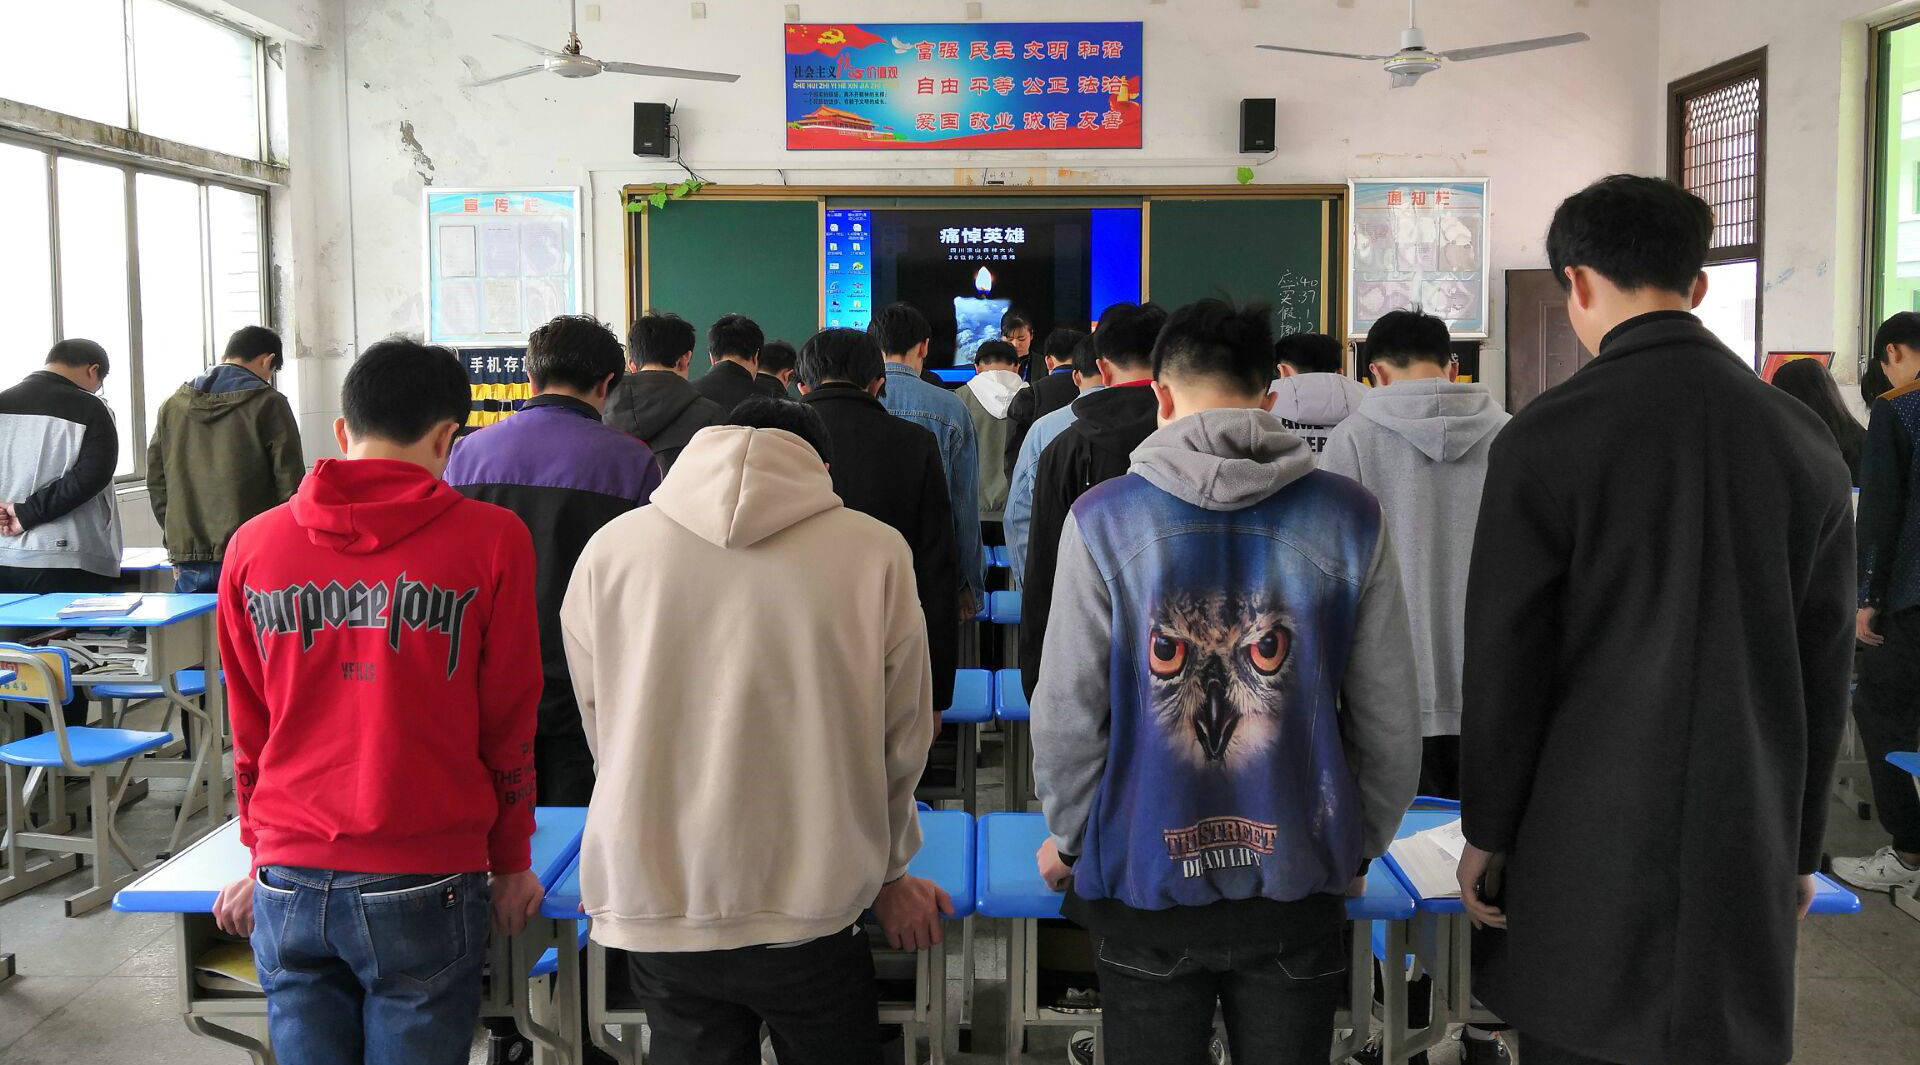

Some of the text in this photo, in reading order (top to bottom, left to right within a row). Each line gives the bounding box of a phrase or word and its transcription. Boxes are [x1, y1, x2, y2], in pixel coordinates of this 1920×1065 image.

[915, 41, 1123, 60] 富强 民主 文明 和谐
[916, 76, 1123, 95] 自由 平等 公正 法治
[915, 112, 1123, 131] 爱国 敬业 诚信 友善
[1387, 190, 1450, 207] 通知栏
[940, 227, 1025, 244] 痛悼英雄
[1199, 821, 1278, 849] STREET
